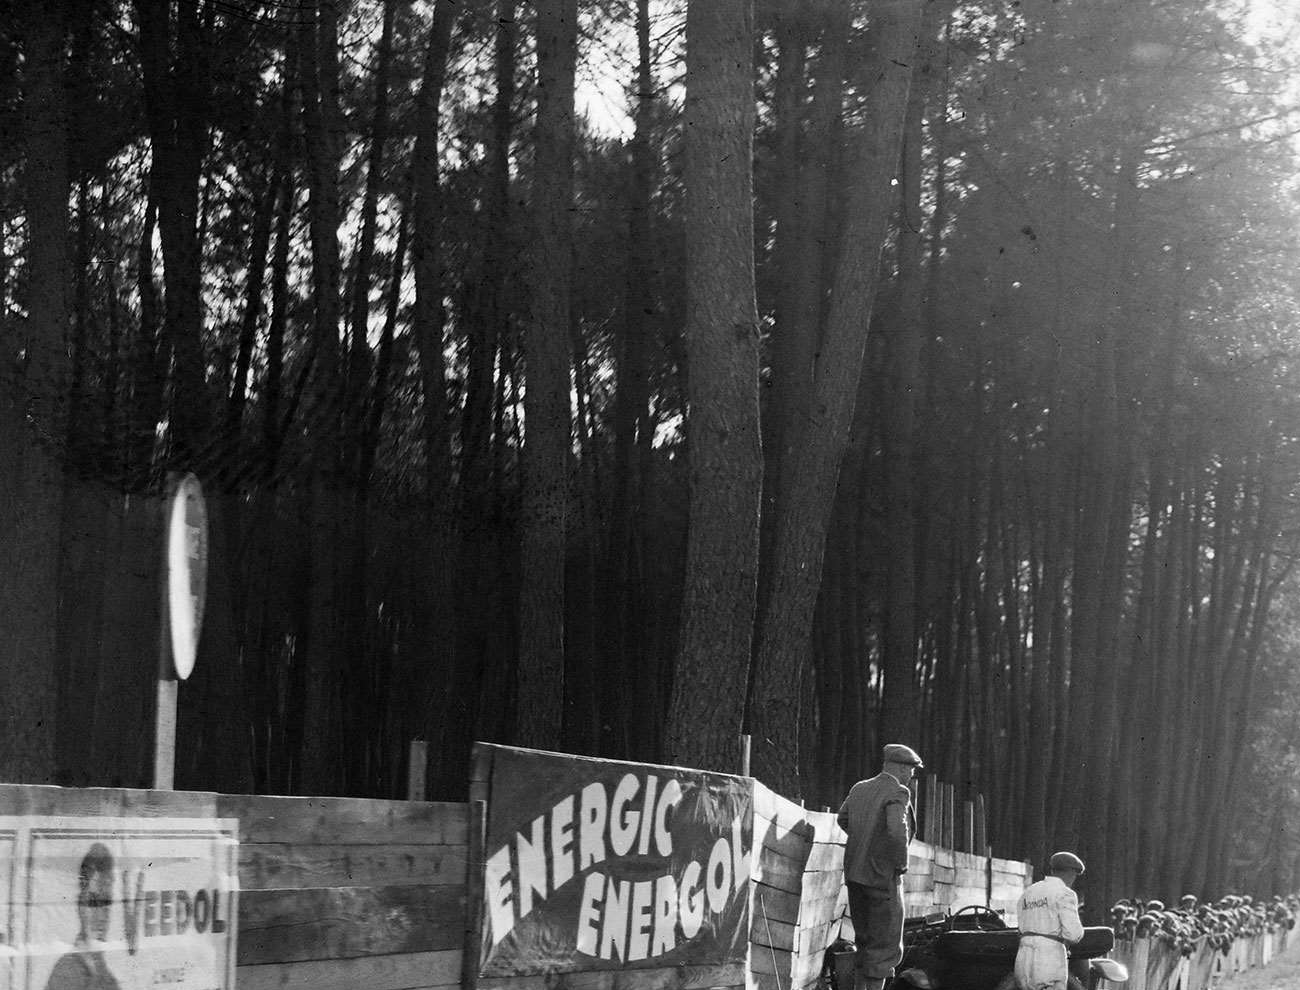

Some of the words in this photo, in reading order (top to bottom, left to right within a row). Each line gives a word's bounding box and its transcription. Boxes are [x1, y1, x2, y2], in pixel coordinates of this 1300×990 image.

[122, 869, 226, 956] VEEDOL
[486, 772, 683, 946] ENERGIC
[576, 815, 752, 964] ENERGOL
